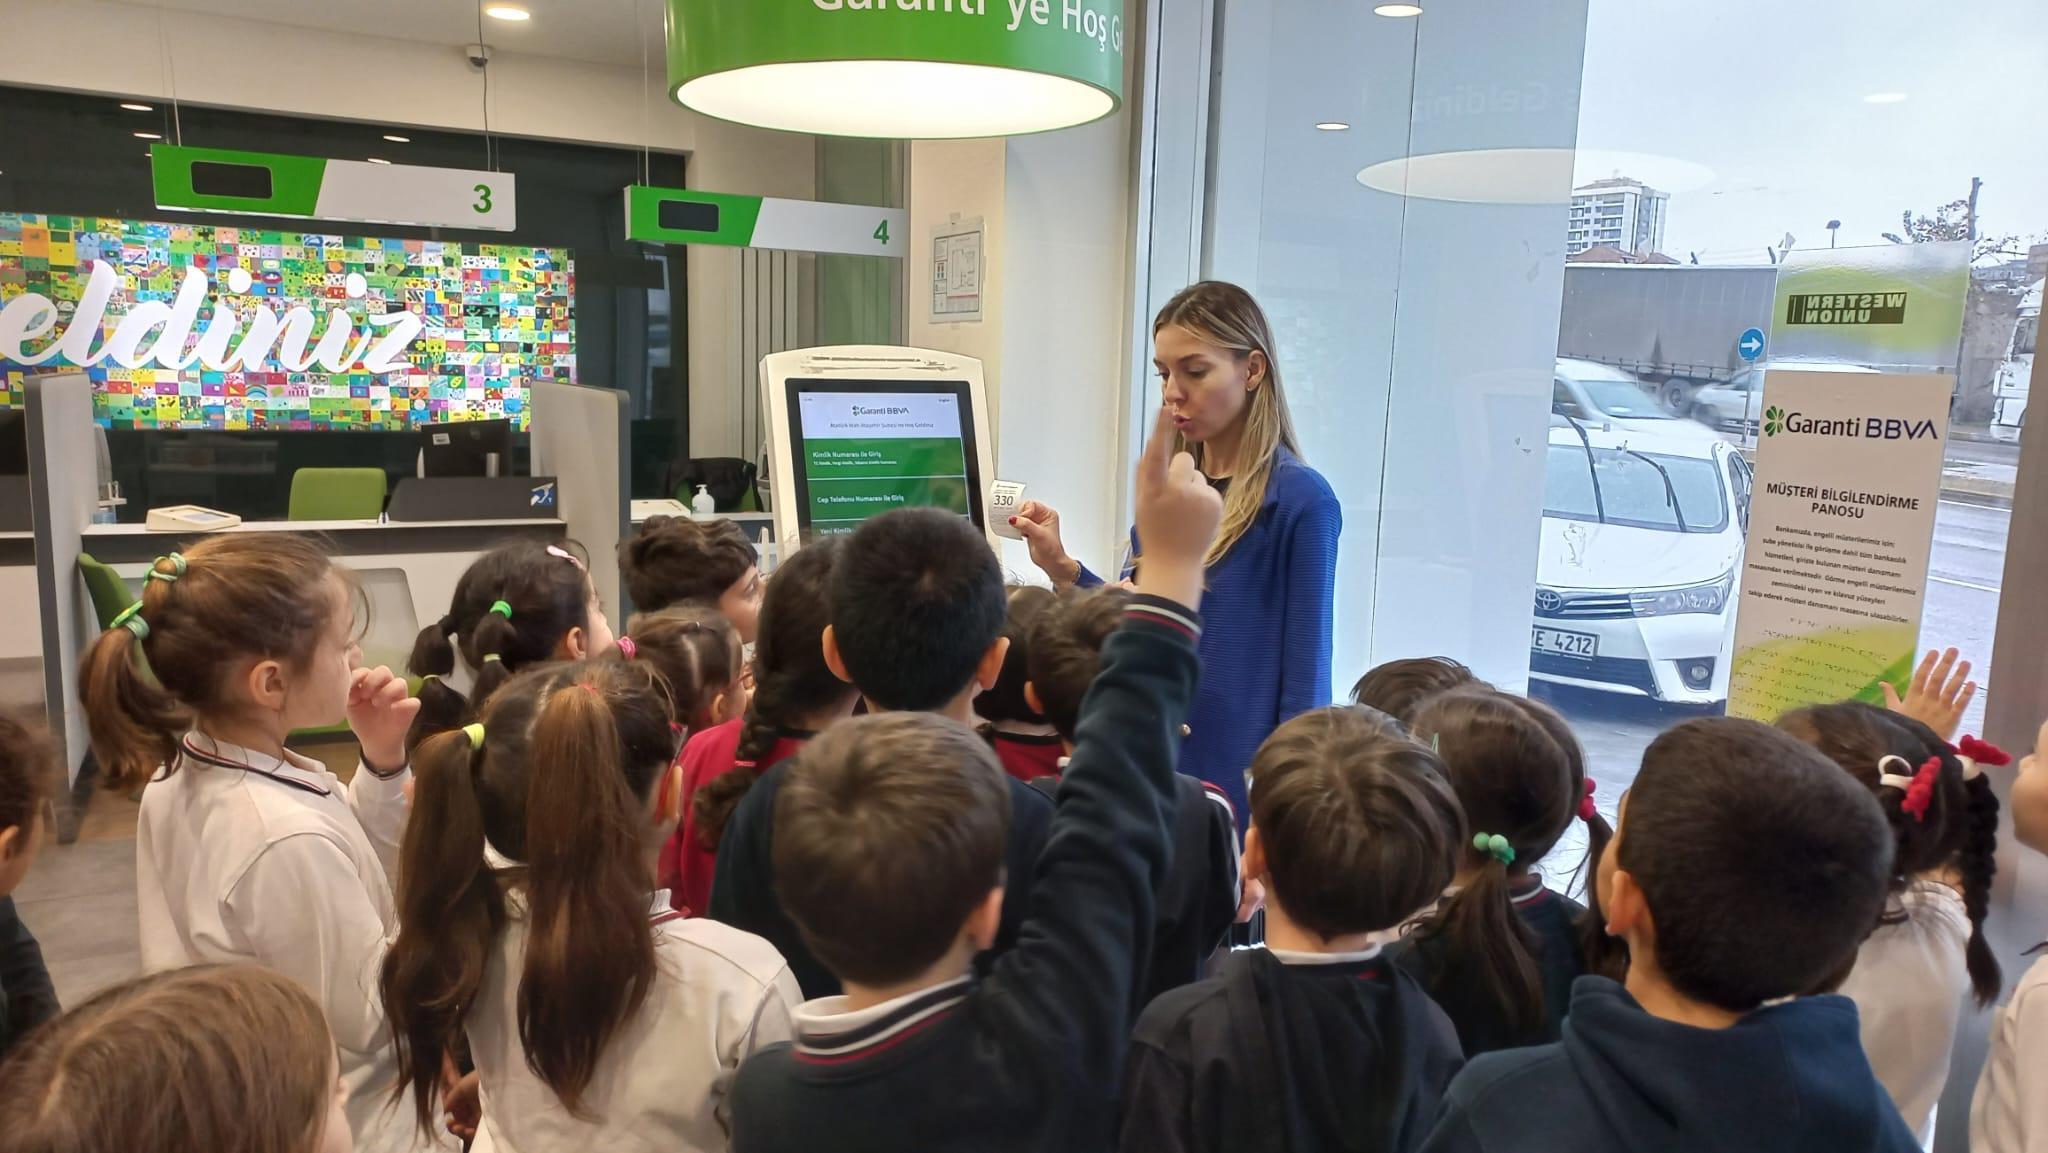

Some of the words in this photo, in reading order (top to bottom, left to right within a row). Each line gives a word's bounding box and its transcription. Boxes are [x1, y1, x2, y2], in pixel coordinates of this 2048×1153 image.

[1062, 0, 1107, 52] Hoş
[472, 184, 493, 214] 3
[872, 219, 890, 245] 4
[859, 406, 886, 415] Garanti
[886, 406, 910, 415] BBVA
[1785, 412, 1861, 437] Garanti
[1865, 418, 1938, 440] BBVA
[993, 495, 1014, 506] 330
[1766, 482, 1818, 498] MÜŞTERİ
[1821, 487, 1919, 511] BİLGİLENDİRME
[1811, 502, 1865, 519] PANOSU
[1554, 633, 1592, 655] 4212
